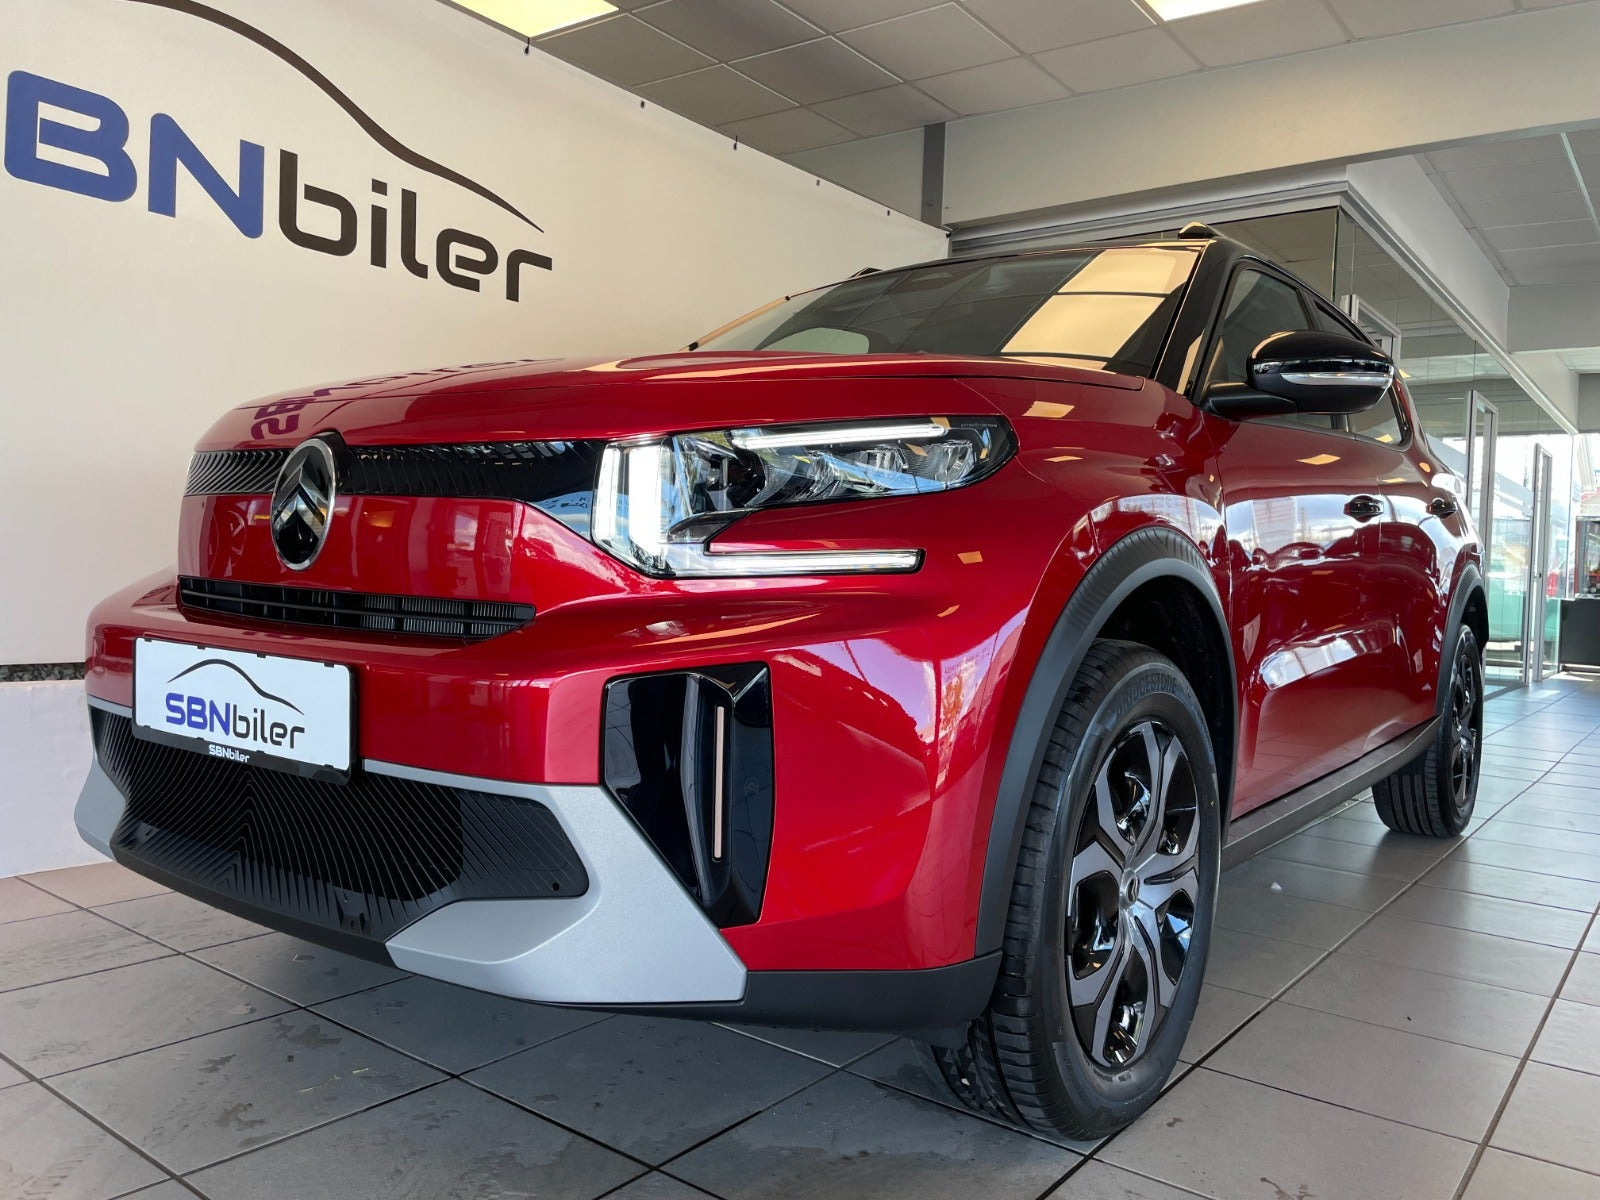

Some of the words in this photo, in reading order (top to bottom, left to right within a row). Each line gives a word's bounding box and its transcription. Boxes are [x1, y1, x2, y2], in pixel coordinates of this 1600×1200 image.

[4, 70, 553, 303] BNbiler
[165, 692, 306, 749] SBNbiler
[208, 744, 250, 763] SBNbiler
